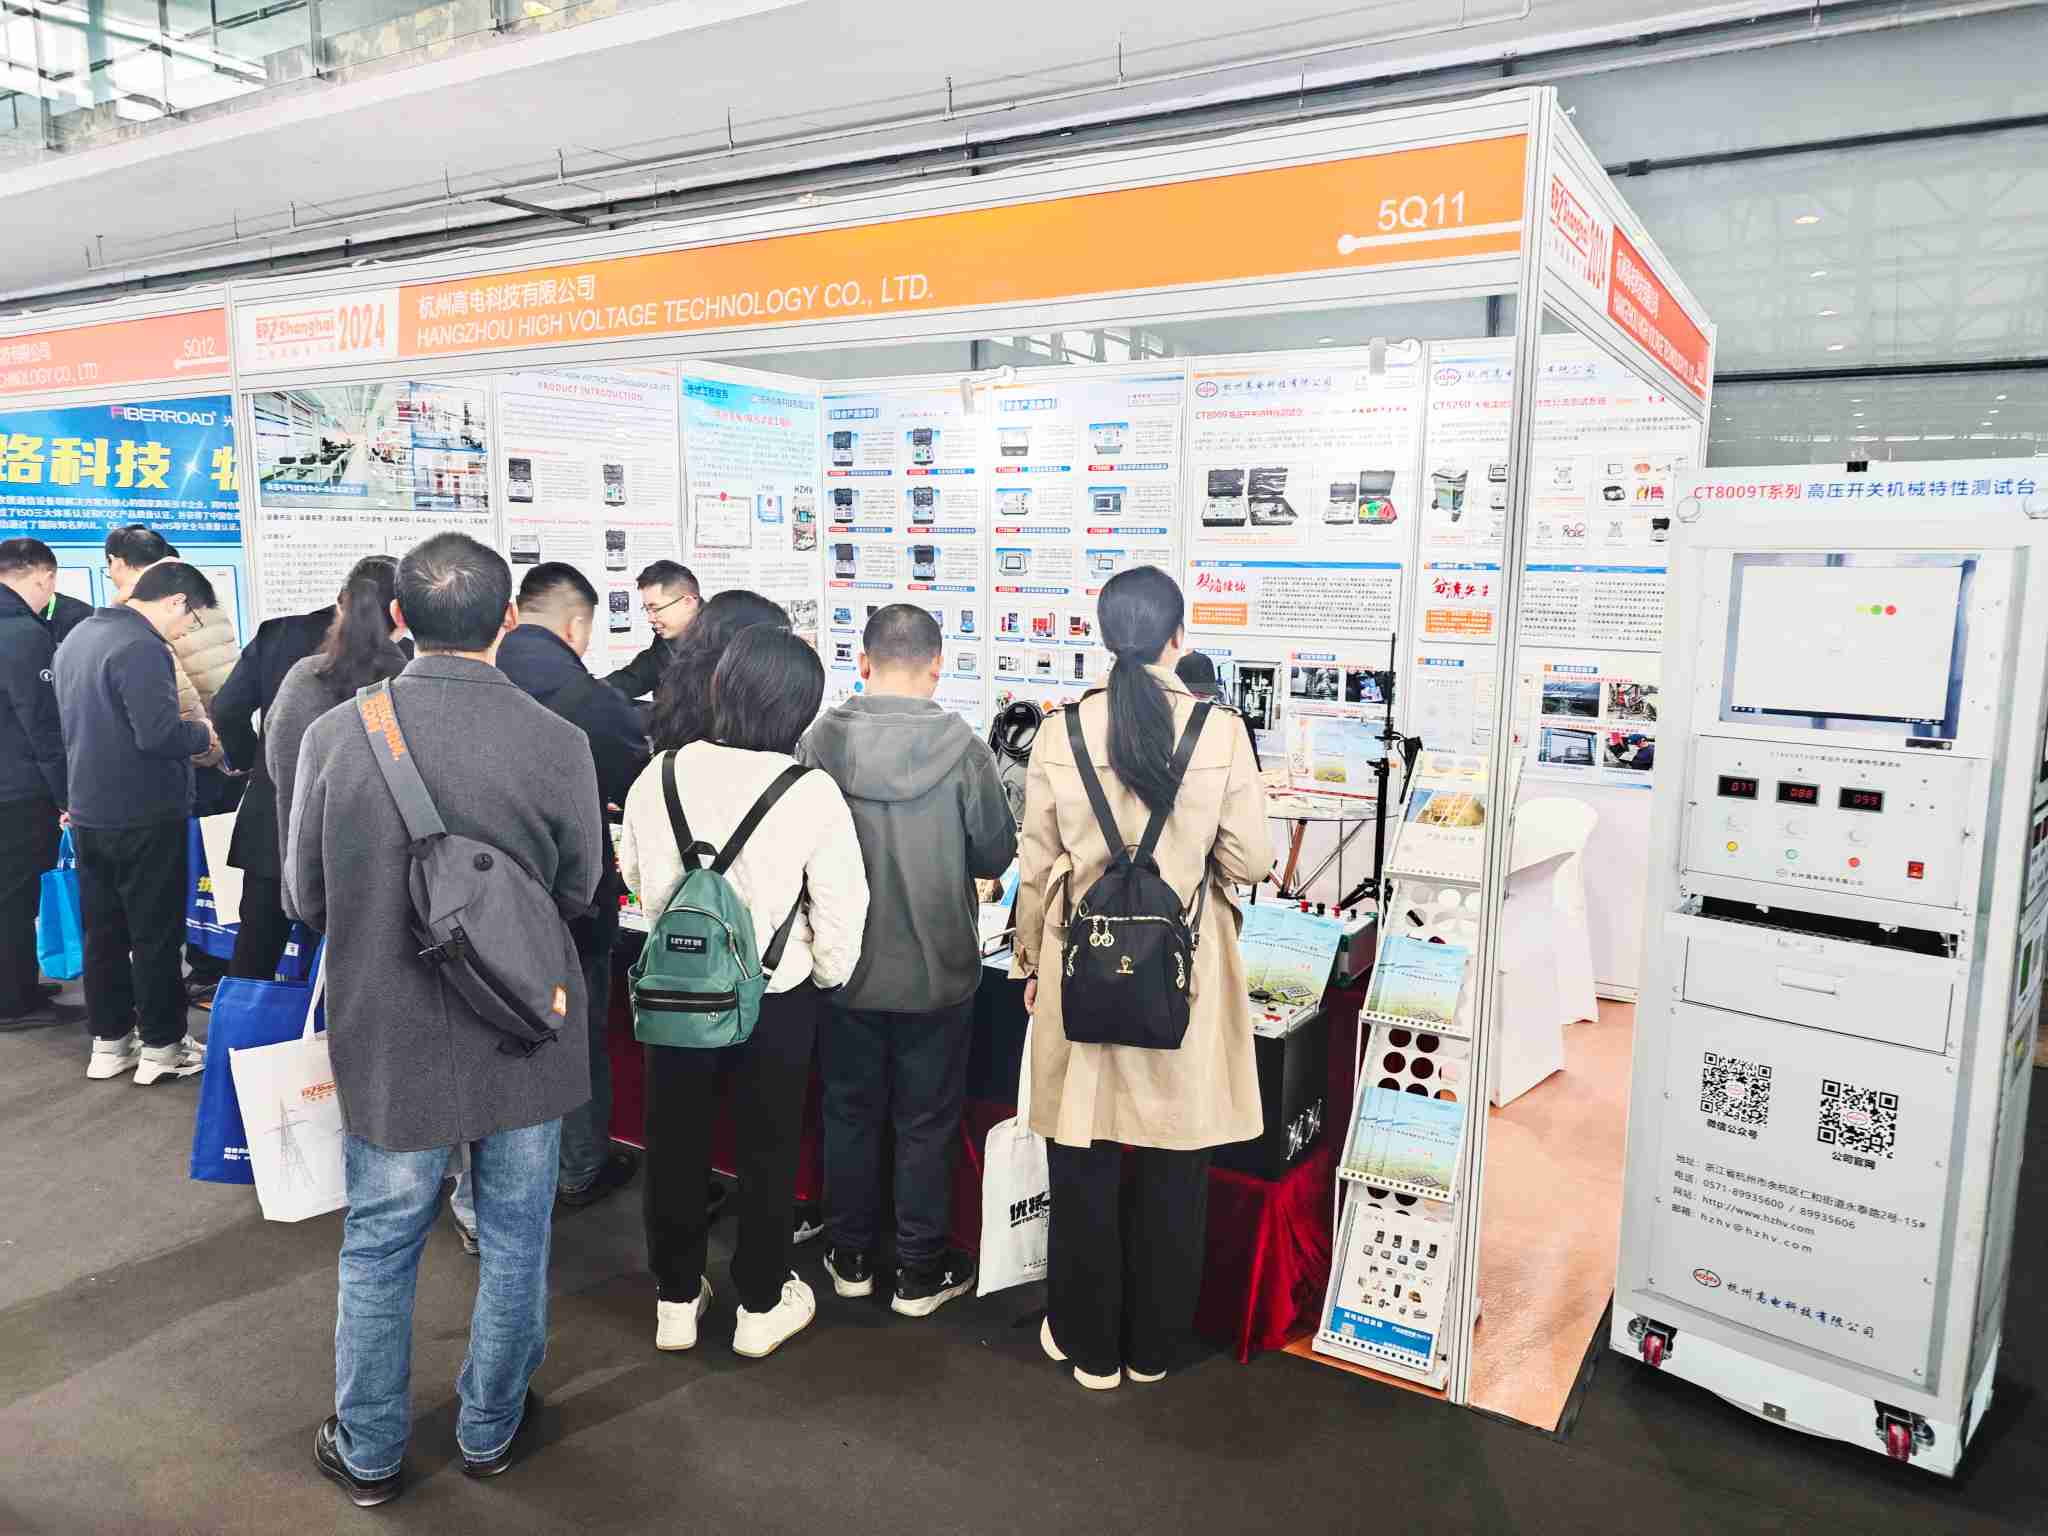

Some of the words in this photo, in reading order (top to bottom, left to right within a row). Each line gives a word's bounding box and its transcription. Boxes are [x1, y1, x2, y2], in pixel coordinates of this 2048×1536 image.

[1377, 190, 1464, 231] 5Q11
[416, 319, 513, 348] HANGZHOU
[517, 312, 566, 337] HIGH
[569, 303, 657, 332] VOLTAGE
[662, 286, 820, 322] TECHNOLOGY
[880, 273, 936, 304] LTD.
[417, 275, 595, 320] 杭州高电科技有限公司
[338, 304, 384, 352] 2024
[1807, 478, 2036, 498] 高压开关机械特性测试台
[1831, 1150, 1877, 1170] 公司官网
